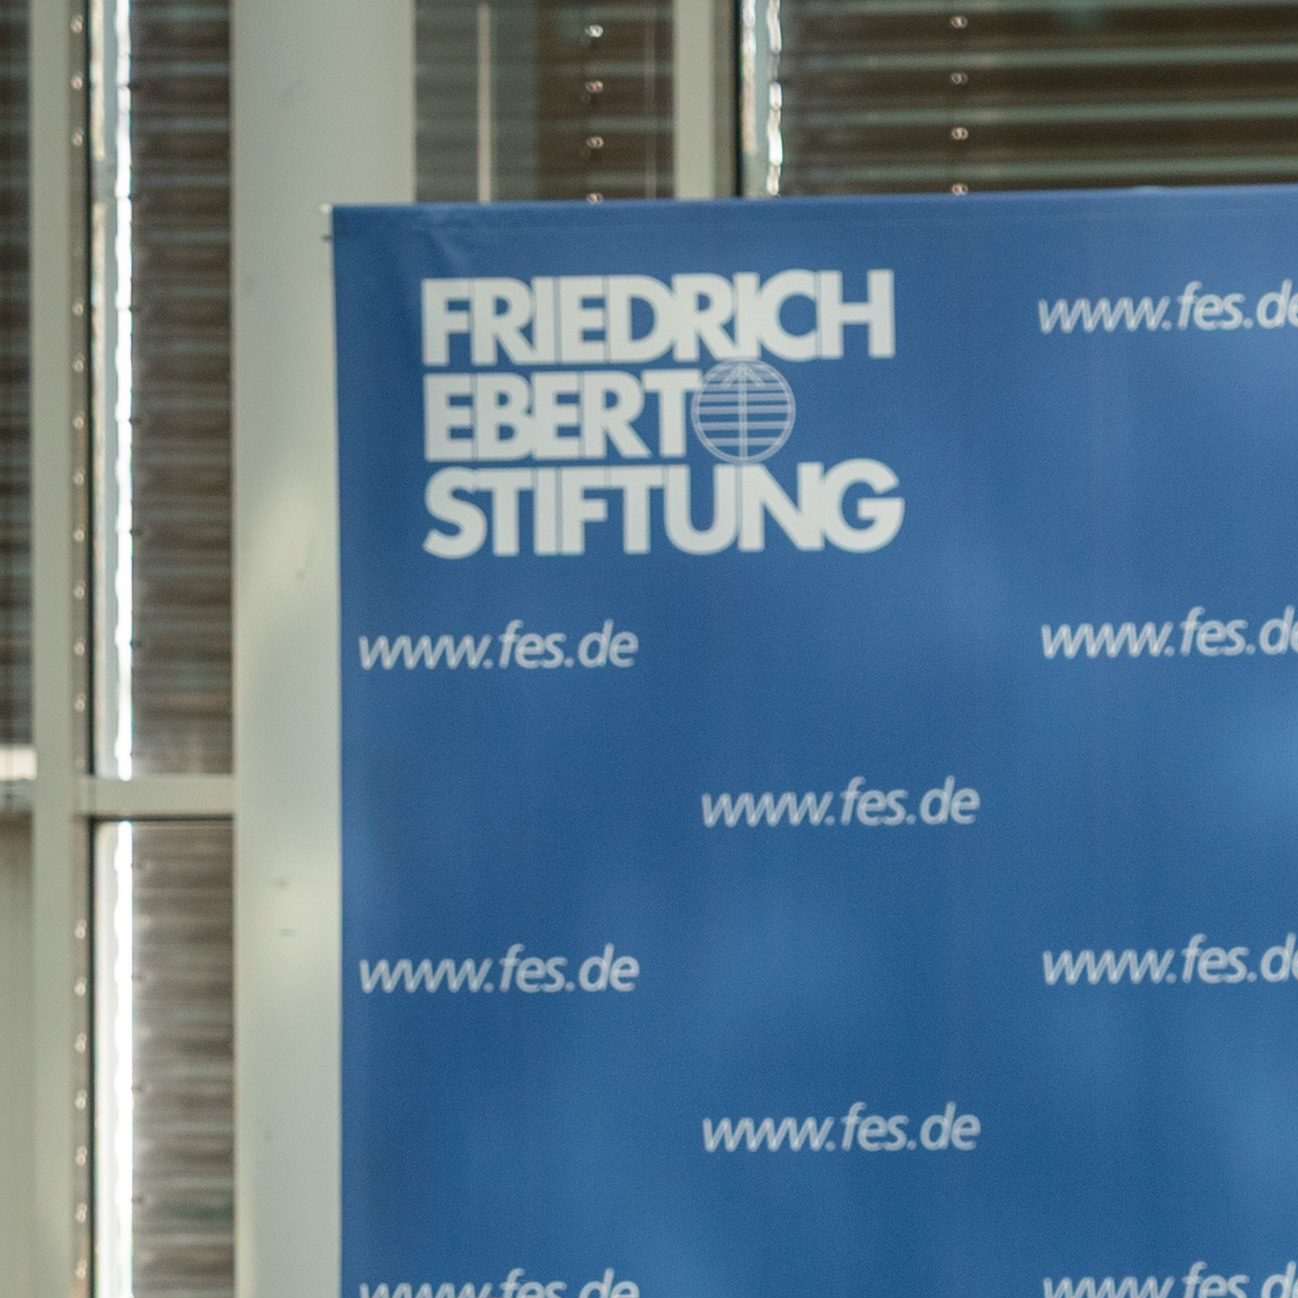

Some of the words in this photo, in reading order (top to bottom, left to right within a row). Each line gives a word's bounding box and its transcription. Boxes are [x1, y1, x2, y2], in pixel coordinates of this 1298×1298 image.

[421, 269, 896, 366] FRIEDRICH
[424, 371, 703, 463] EBERT
[422, 458, 906, 559] STIFTUNG
[359, 619, 638, 670] www.fes.de
[701, 775, 980, 827] www.fes.de
[360, 943, 640, 993] www.fes.de
[703, 1101, 981, 1152] www.fes.de
